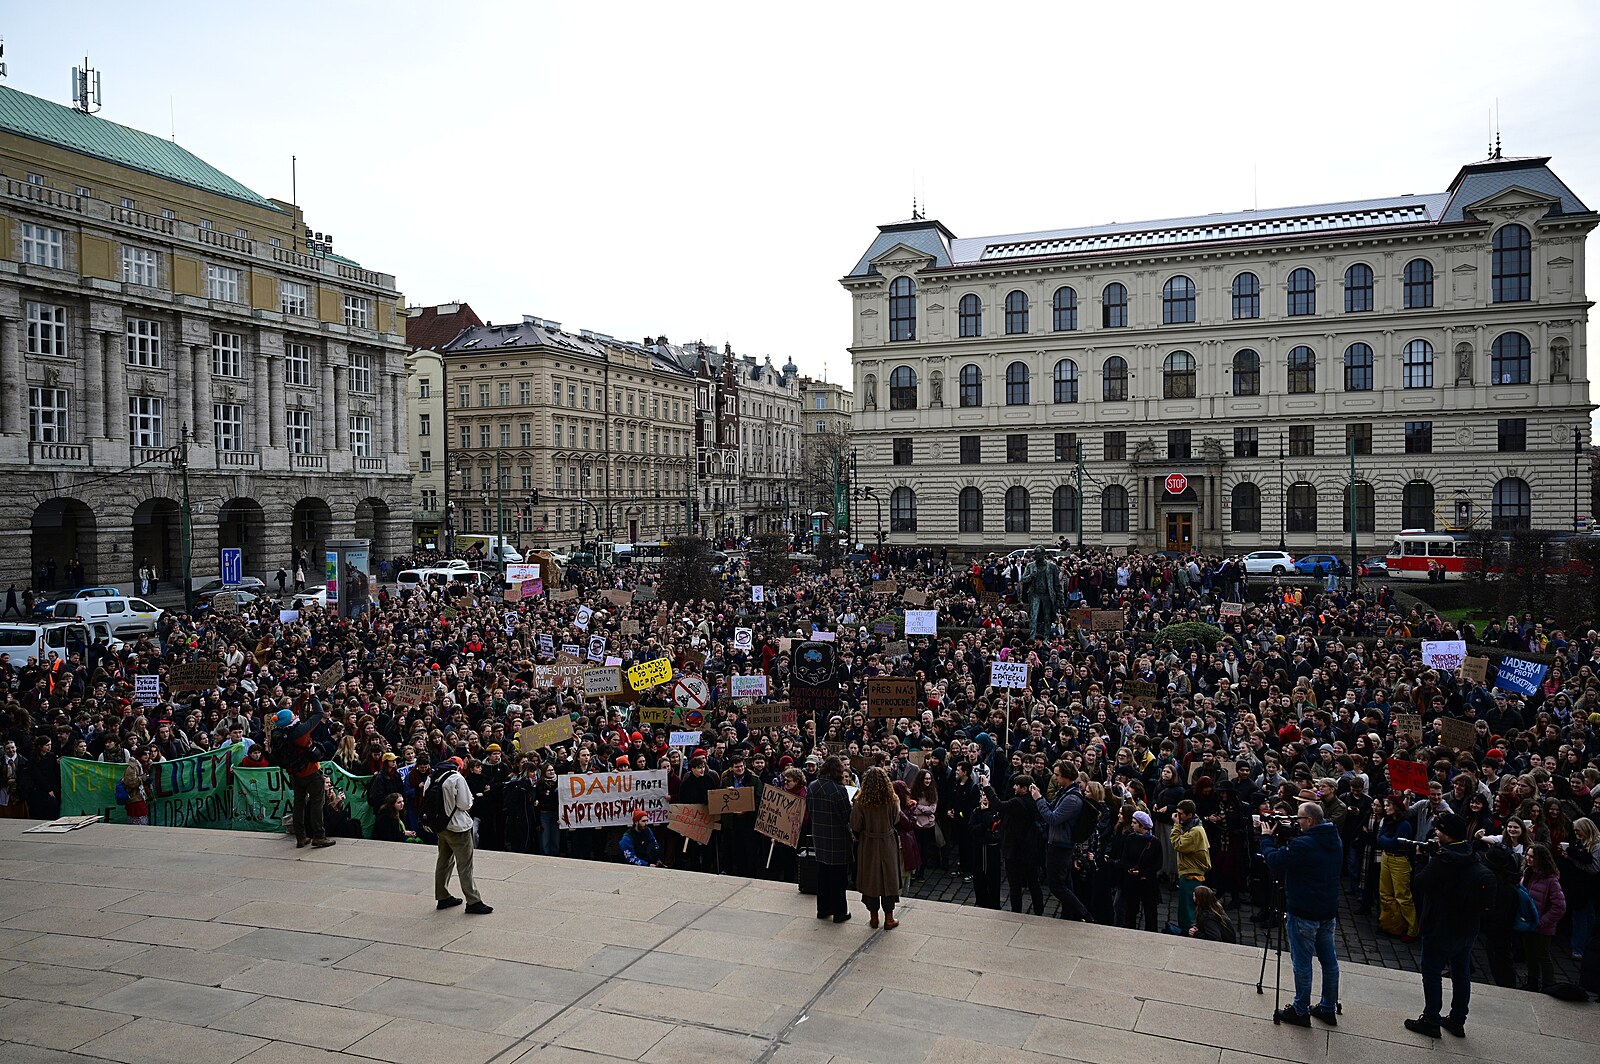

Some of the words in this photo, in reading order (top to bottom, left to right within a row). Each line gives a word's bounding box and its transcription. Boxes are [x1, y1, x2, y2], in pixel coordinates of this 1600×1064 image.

[1167, 478, 1186, 489] STOP
[1501, 656, 1541, 675] JADERKA
[1514, 669, 1534, 679] PROTI
[992, 672, 1026, 682] ZPÁTEČKU
[872, 684, 891, 694] PŘES
[896, 686, 915, 695] NÁS
[871, 696, 917, 707] NEPROJEDEŠ
[154, 750, 234, 797] LIDEM
[570, 774, 633, 798] DAMU
[635, 780, 662, 791] PROTI
[763, 787, 797, 811] LOUTKY
[562, 796, 645, 827] MOTORISTŮM
[649, 799, 663, 808] NA
[682, 805, 712, 826] DAMU
[767, 813, 778, 826] NA
[756, 821, 790, 841] MINISTERSTVO
